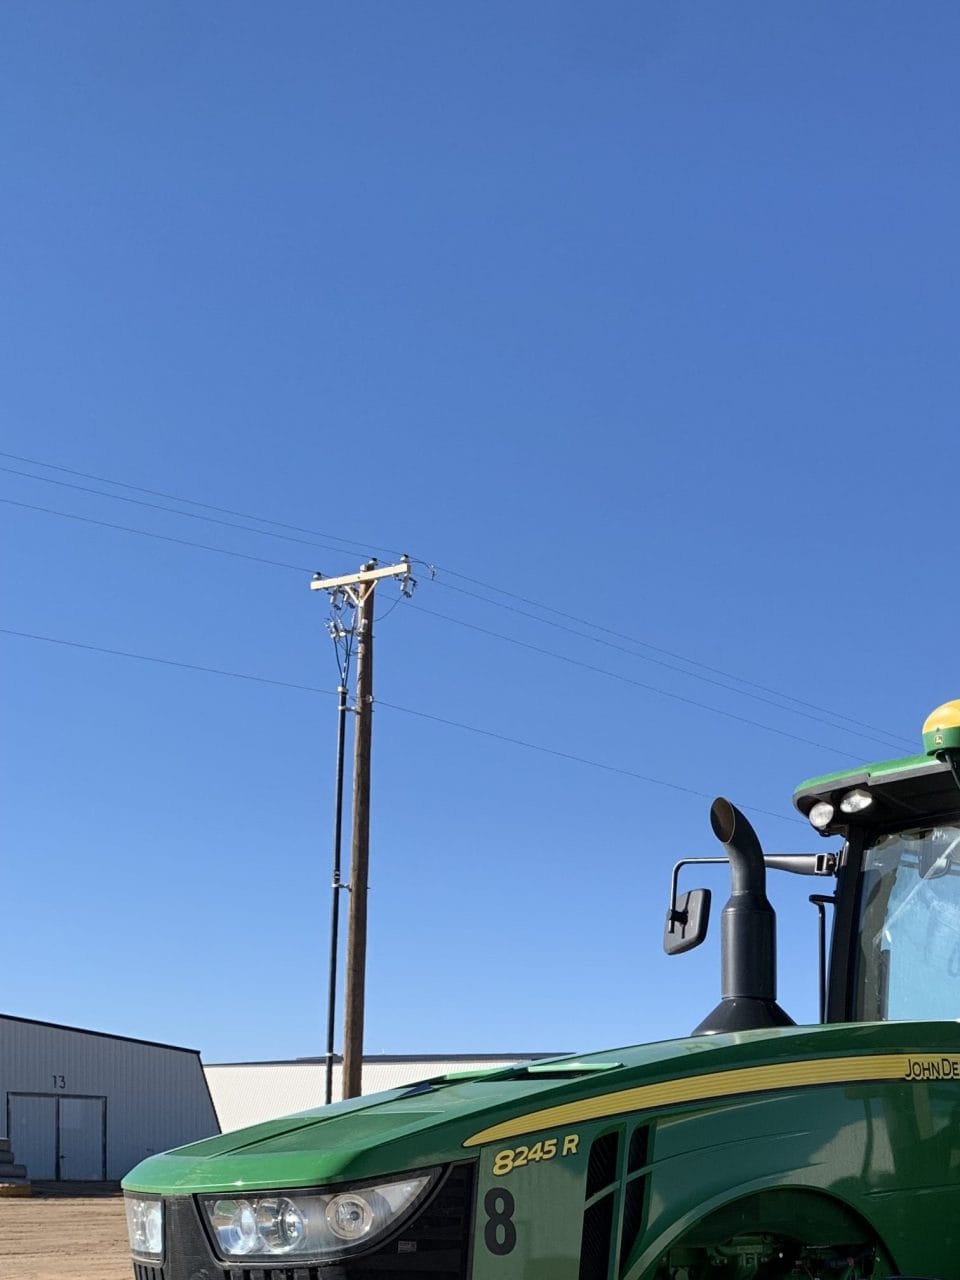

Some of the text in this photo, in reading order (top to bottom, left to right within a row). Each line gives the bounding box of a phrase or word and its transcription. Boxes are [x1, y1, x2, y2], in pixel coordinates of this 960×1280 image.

[52, 1075, 66, 1089] 13
[904, 1057, 940, 1079] JOHN
[492, 1134, 579, 1176] 8245 R
[484, 1187, 516, 1256] 8
